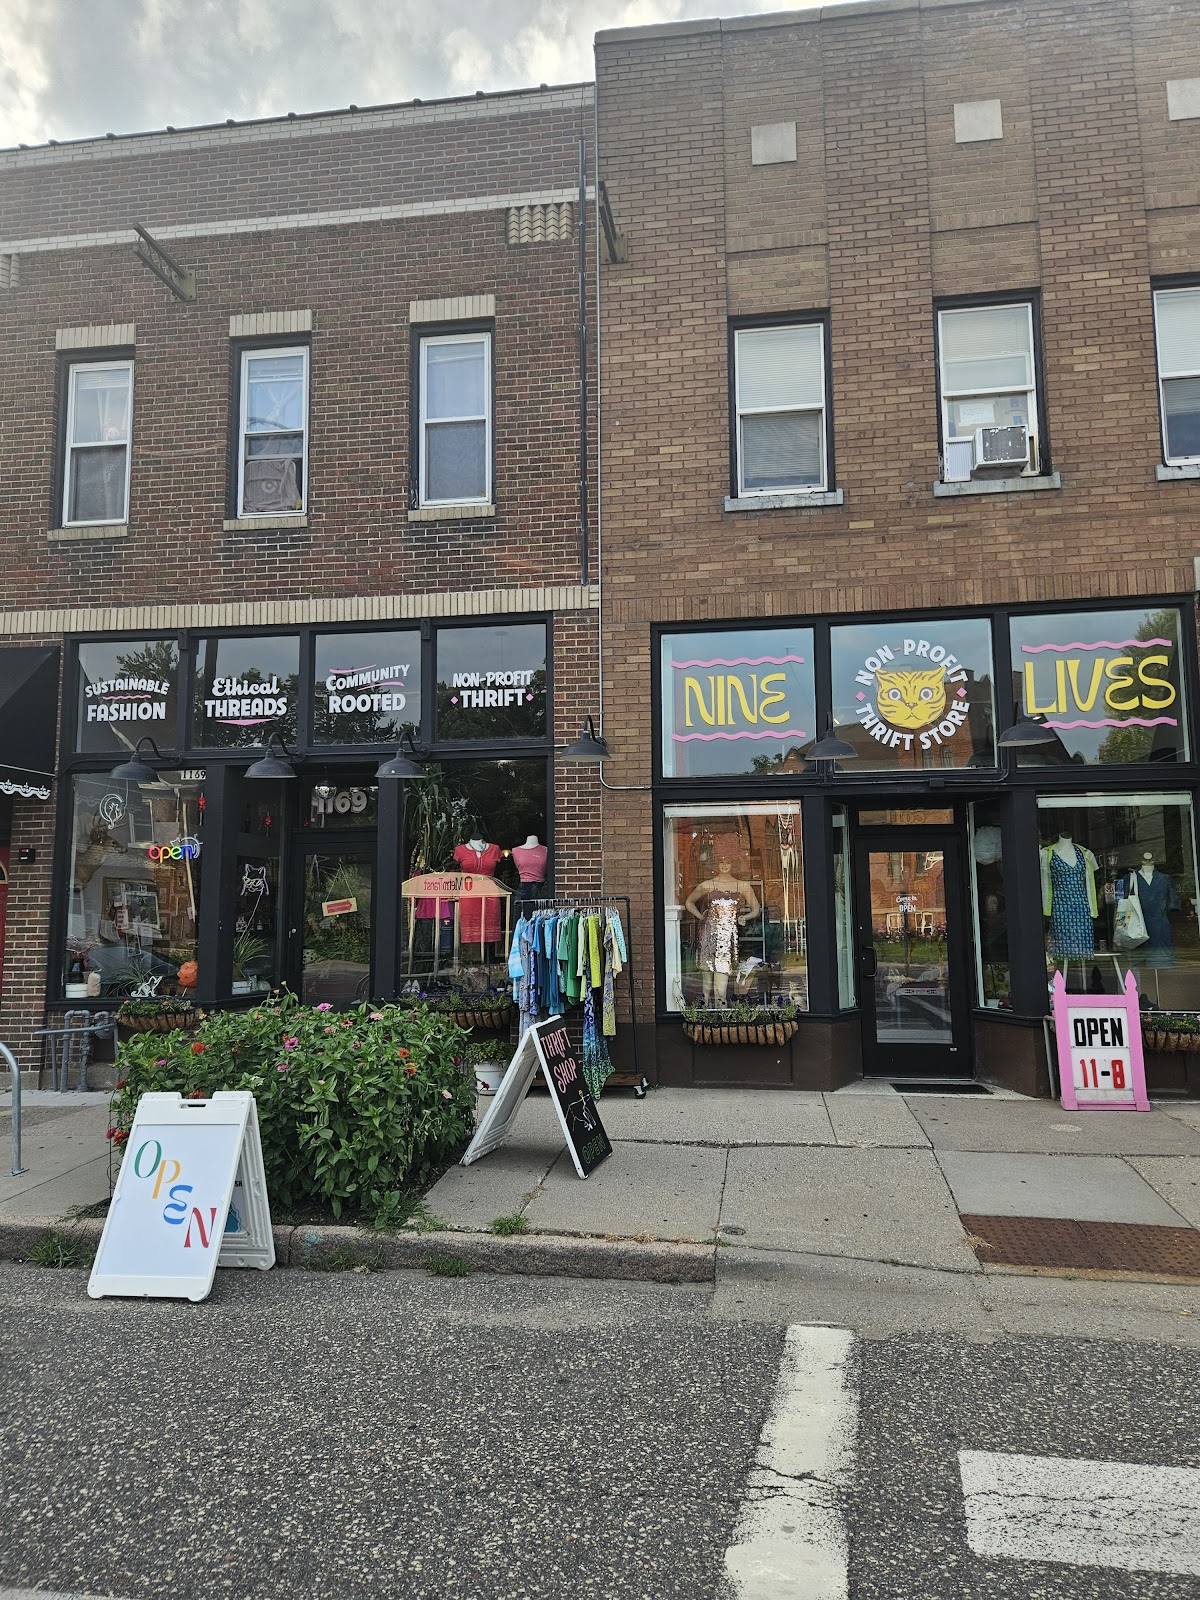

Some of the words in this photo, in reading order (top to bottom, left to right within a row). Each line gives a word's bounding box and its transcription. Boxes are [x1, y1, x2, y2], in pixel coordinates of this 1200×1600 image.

[855, 639, 968, 686] NON-PROFIT
[85, 678, 170, 698] SUSTAINABLE
[212, 676, 280, 696] Ethical
[325, 664, 410, 691] COMMUNITY
[452, 670, 534, 687] NON-PROFIT
[1025, 655, 1176, 713] LIVES
[204, 697, 287, 717] THREADS
[328, 693, 406, 713] ROOTED
[460, 688, 526, 708] THRIFT
[685, 673, 790, 727] NINE
[87, 702, 166, 721] FASHION
[855, 702, 914, 750] THRIFT
[919, 700, 970, 750] STORE
[183, 770, 206, 779] 1169
[317, 790, 367, 814] 1169
[148, 845, 193, 863] open
[540, 1027, 571, 1059] THRIFT
[1074, 1018, 1123, 1046] OPEN
[554, 1057, 577, 1094] SHOP
[1080, 1059, 1125, 1088] 11-8
[134, 1139, 217, 1248] OPEN
